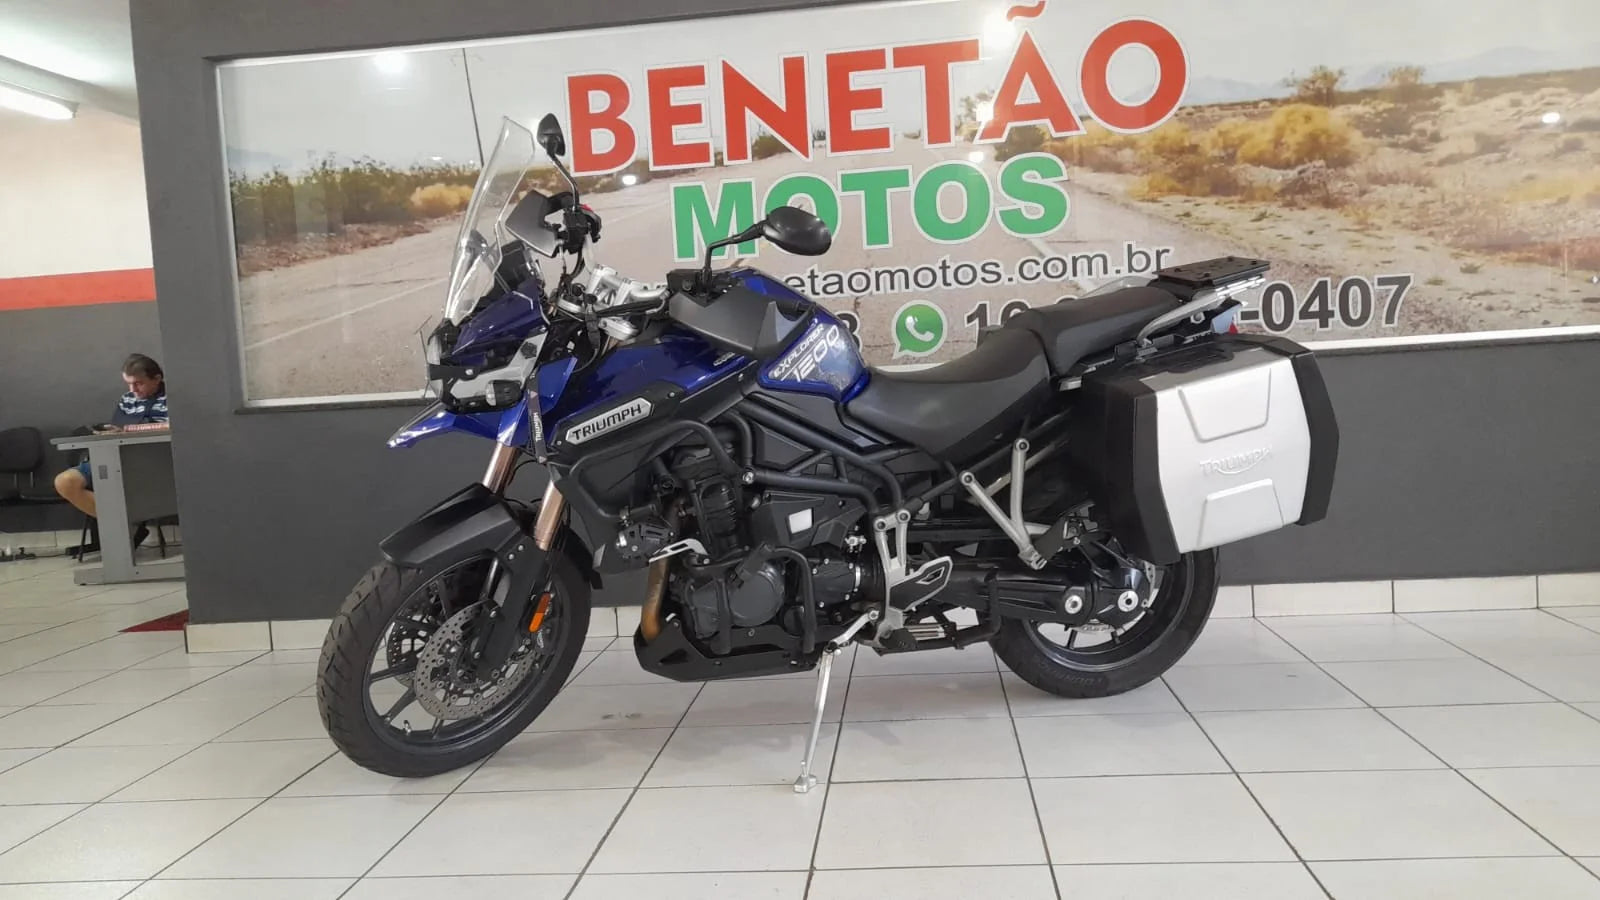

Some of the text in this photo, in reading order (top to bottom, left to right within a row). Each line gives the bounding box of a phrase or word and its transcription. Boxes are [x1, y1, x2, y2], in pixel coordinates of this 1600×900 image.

[566, 0, 1187, 174] BENETÃO
[673, 154, 1068, 259] MOTOS
[773, 323, 824, 378] EXPLORER
[793, 324, 840, 383] 1200
[572, 403, 642, 441] TRIUMPH
[1199, 447, 1273, 477] TRIUMPH
